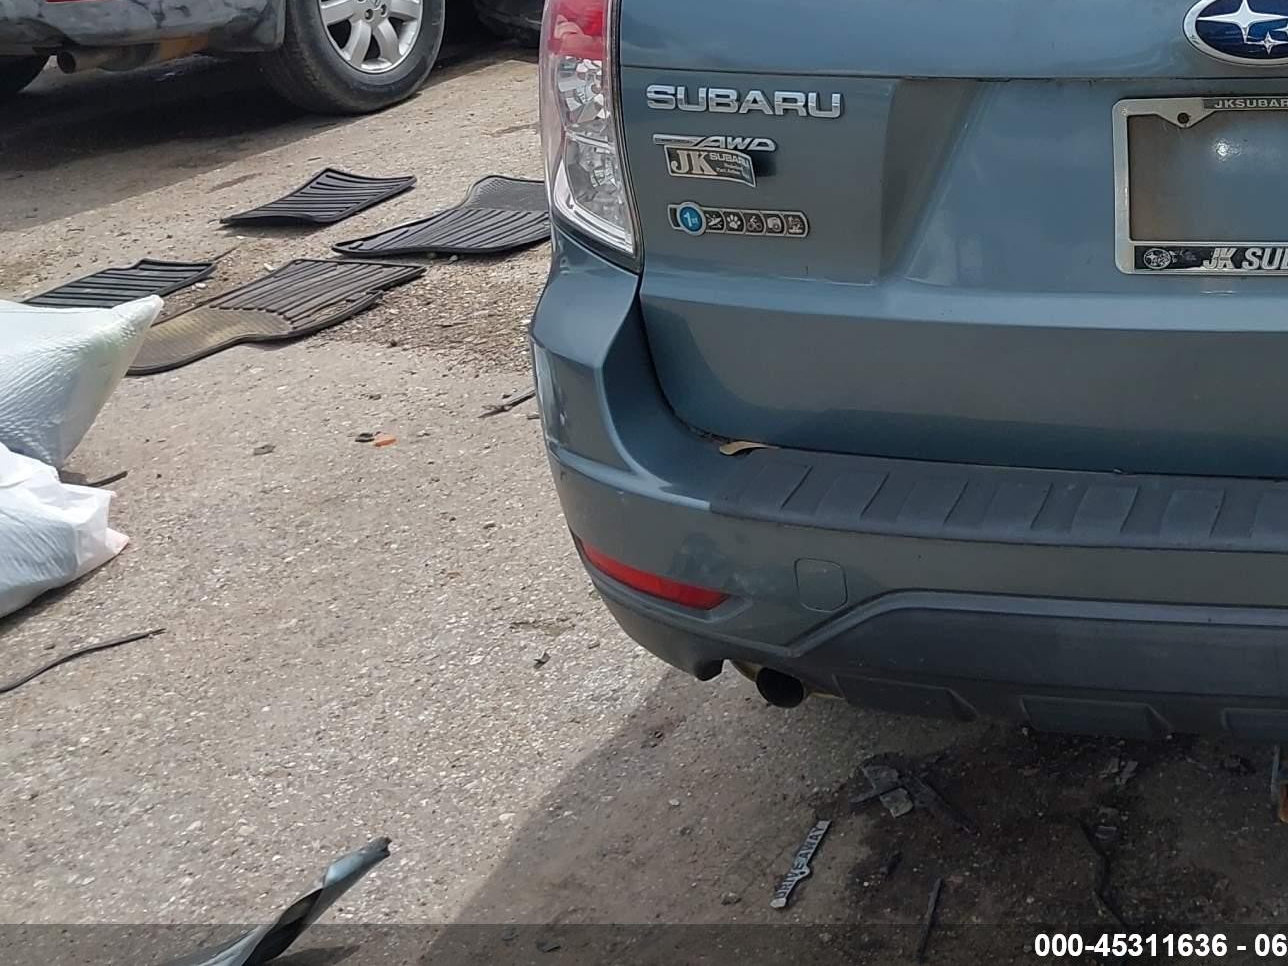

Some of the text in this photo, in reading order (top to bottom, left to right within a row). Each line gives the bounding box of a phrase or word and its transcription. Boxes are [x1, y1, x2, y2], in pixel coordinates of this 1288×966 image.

[646, 84, 842, 118] SUBARU
[697, 135, 777, 152] AWD
[670, 149, 751, 176] JK SUBARU
[1202, 247, 1238, 270] JK
